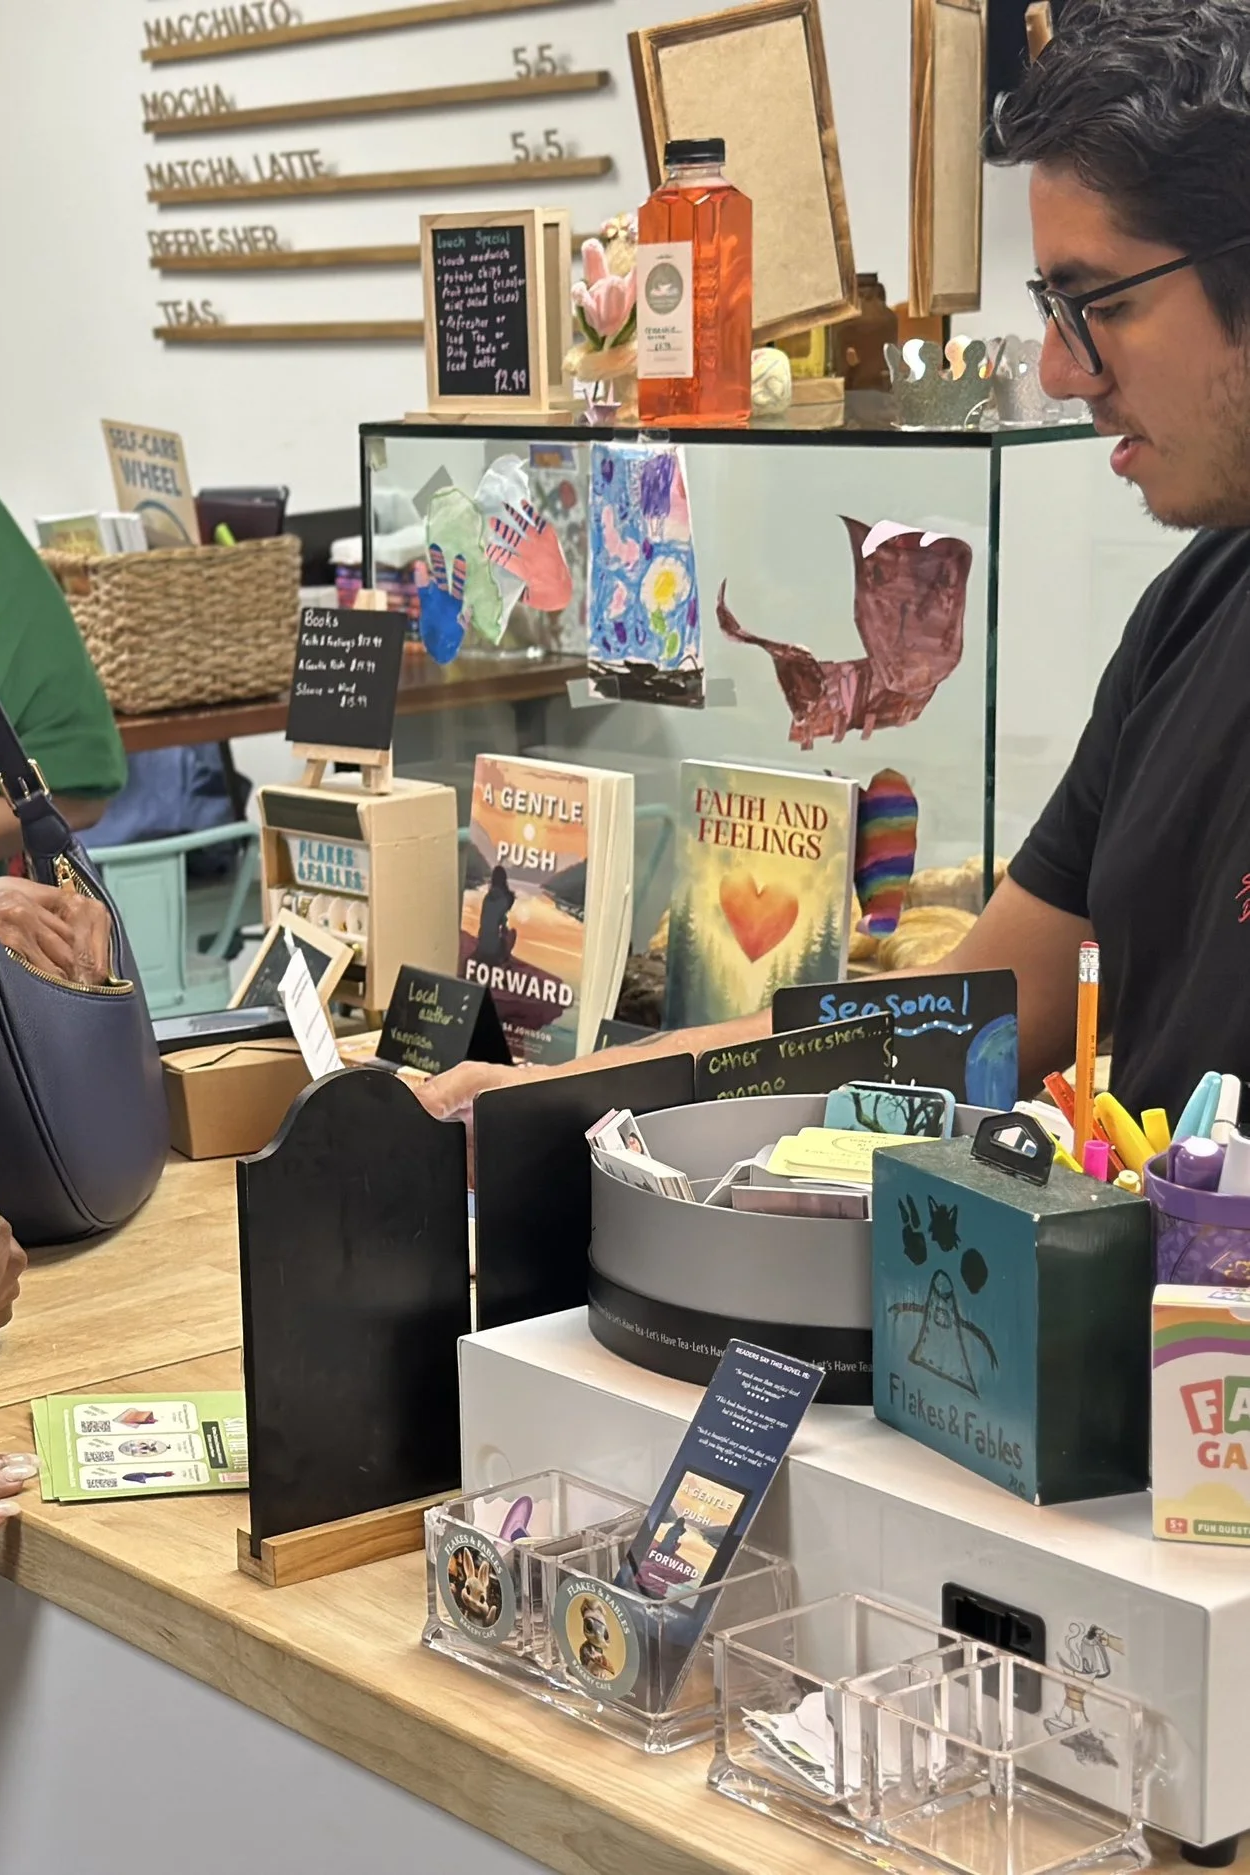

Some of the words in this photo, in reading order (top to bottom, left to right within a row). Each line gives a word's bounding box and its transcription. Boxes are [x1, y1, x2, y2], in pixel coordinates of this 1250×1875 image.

[143, 0, 291, 48] MACCHIATO
[140, 84, 229, 120] MOCHA
[145, 156, 242, 189] MATCHA
[253, 149, 324, 184] LATTE
[147, 226, 282, 258] REFRESHER
[475, 230, 510, 249] Special
[156, 299, 219, 327] TEAS
[109, 427, 179, 462] SELF-CARE
[118, 456, 183, 497] WHEEL
[303, 608, 339, 628] Books
[483, 783, 494, 805] A
[500, 786, 584, 824] GENTLE
[694, 788, 766, 823] FAITH
[778, 801, 829, 832] AND
[697, 817, 823, 861] FEELINGS
[496, 840, 557, 872] PUSH
[408, 980, 440, 1005] Local
[465, 959, 574, 1007] FORWARD
[514, 1027, 552, 1042] JOHNSON
[661, 1333, 676, 1347] Have
[677, 1337, 689, 1350] Tea
[711, 1346, 726, 1357] Hav
[833, 1360, 856, 1373] Have
[735, 1347, 760, 1361] READERS
[759, 1355, 770, 1364] SAY
[770, 1359, 783, 1369] THIS
[783, 1362, 801, 1377] NOVEL
[889, 1372, 946, 1431] Flakes
[948, 1404, 960, 1438] &
[964, 1411, 1023, 1470] Fables
[1187, 1383, 1250, 1432] FA
[1197, 1441, 1248, 1470] GA
[691, 1487, 735, 1511] GENTLE
[682, 1507, 711, 1526] PUSH
[1170, 1519, 1183, 1529] 5+
[1197, 1523, 1216, 1533] FUN
[1218, 1525, 1250, 1536] QUEST
[444, 1534, 470, 1556] FLAKES
[469, 1535, 476, 1546] &
[476, 1539, 503, 1575] FABLES
[648, 1549, 699, 1579] FORWARD
[566, 1581, 597, 1597] FLAKES
[597, 1587, 604, 1596] &
[604, 1592, 631, 1636] FABLES
[459, 1618, 482, 1639] BAKERY
[571, 1659, 595, 1686] BAKERY
